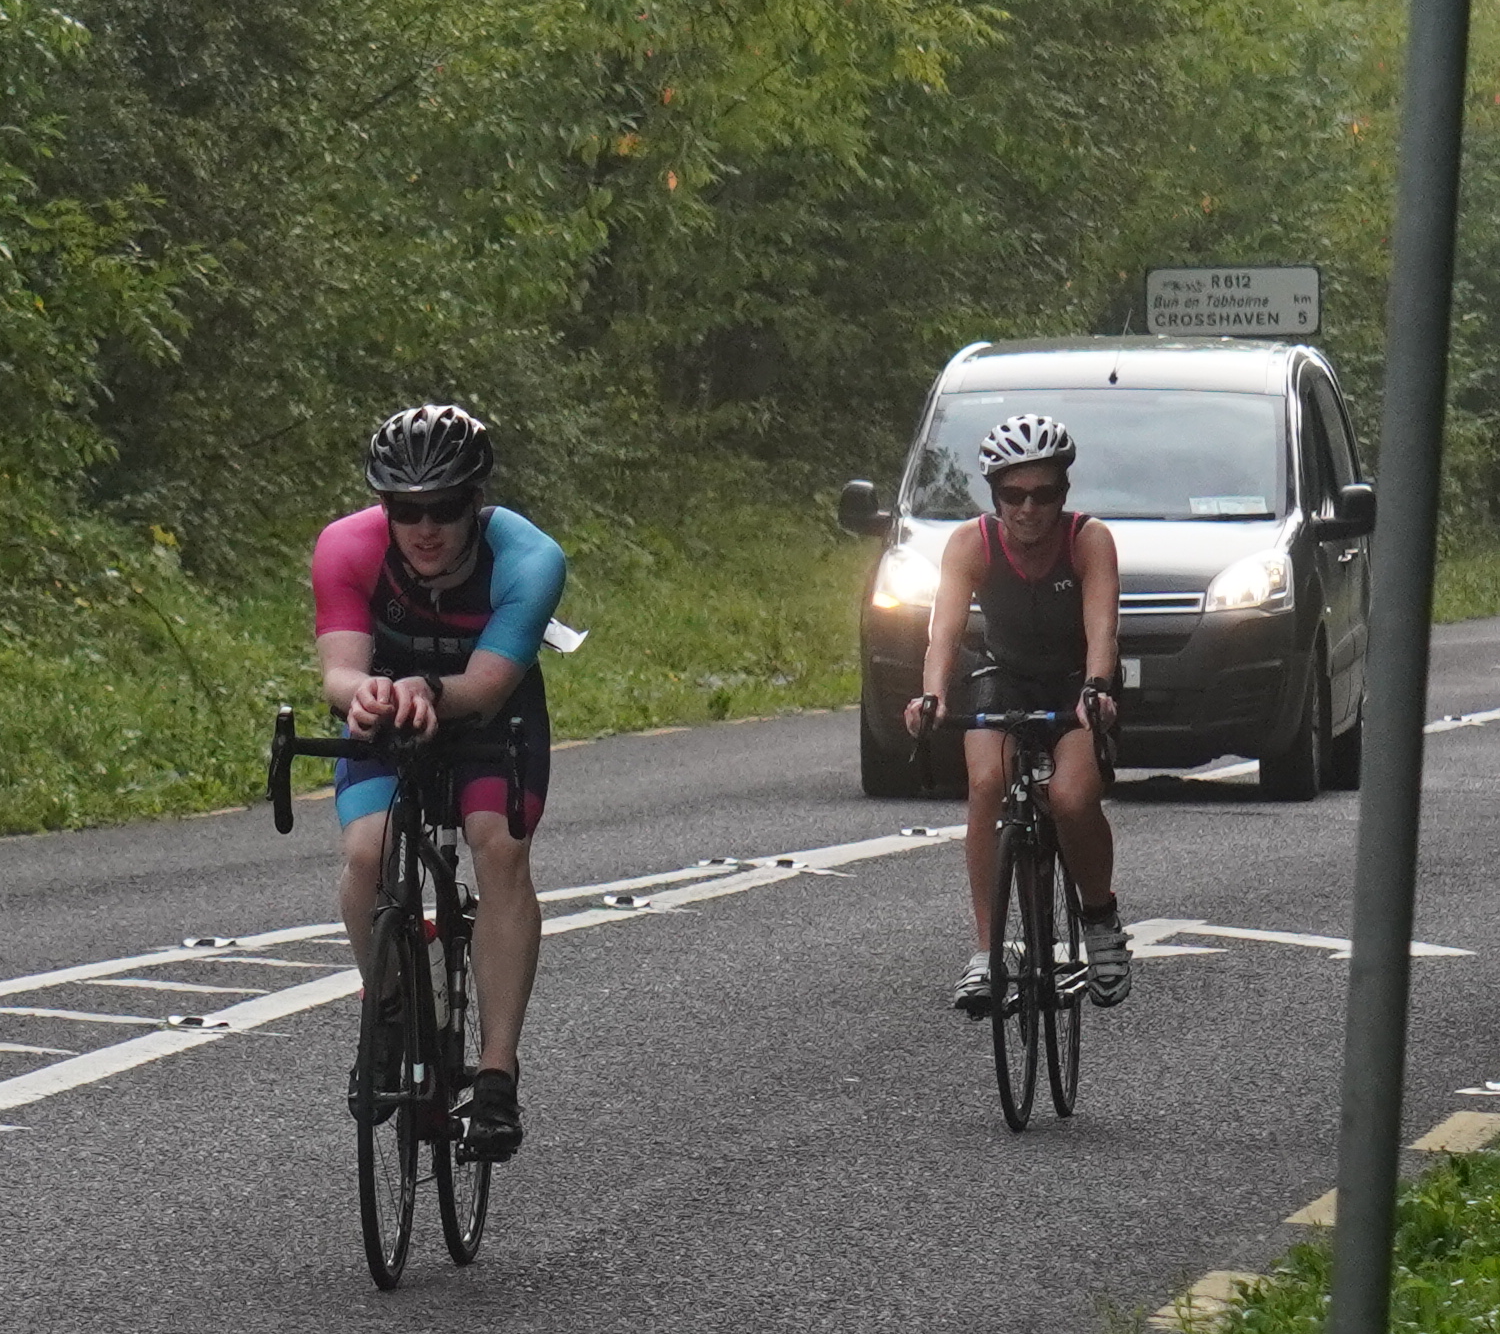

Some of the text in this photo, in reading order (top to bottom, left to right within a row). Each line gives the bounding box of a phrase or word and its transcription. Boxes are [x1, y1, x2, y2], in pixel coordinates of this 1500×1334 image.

[1293, 293, 1311, 304] km
[1155, 310, 1307, 327] CROSSHAVEN 5
